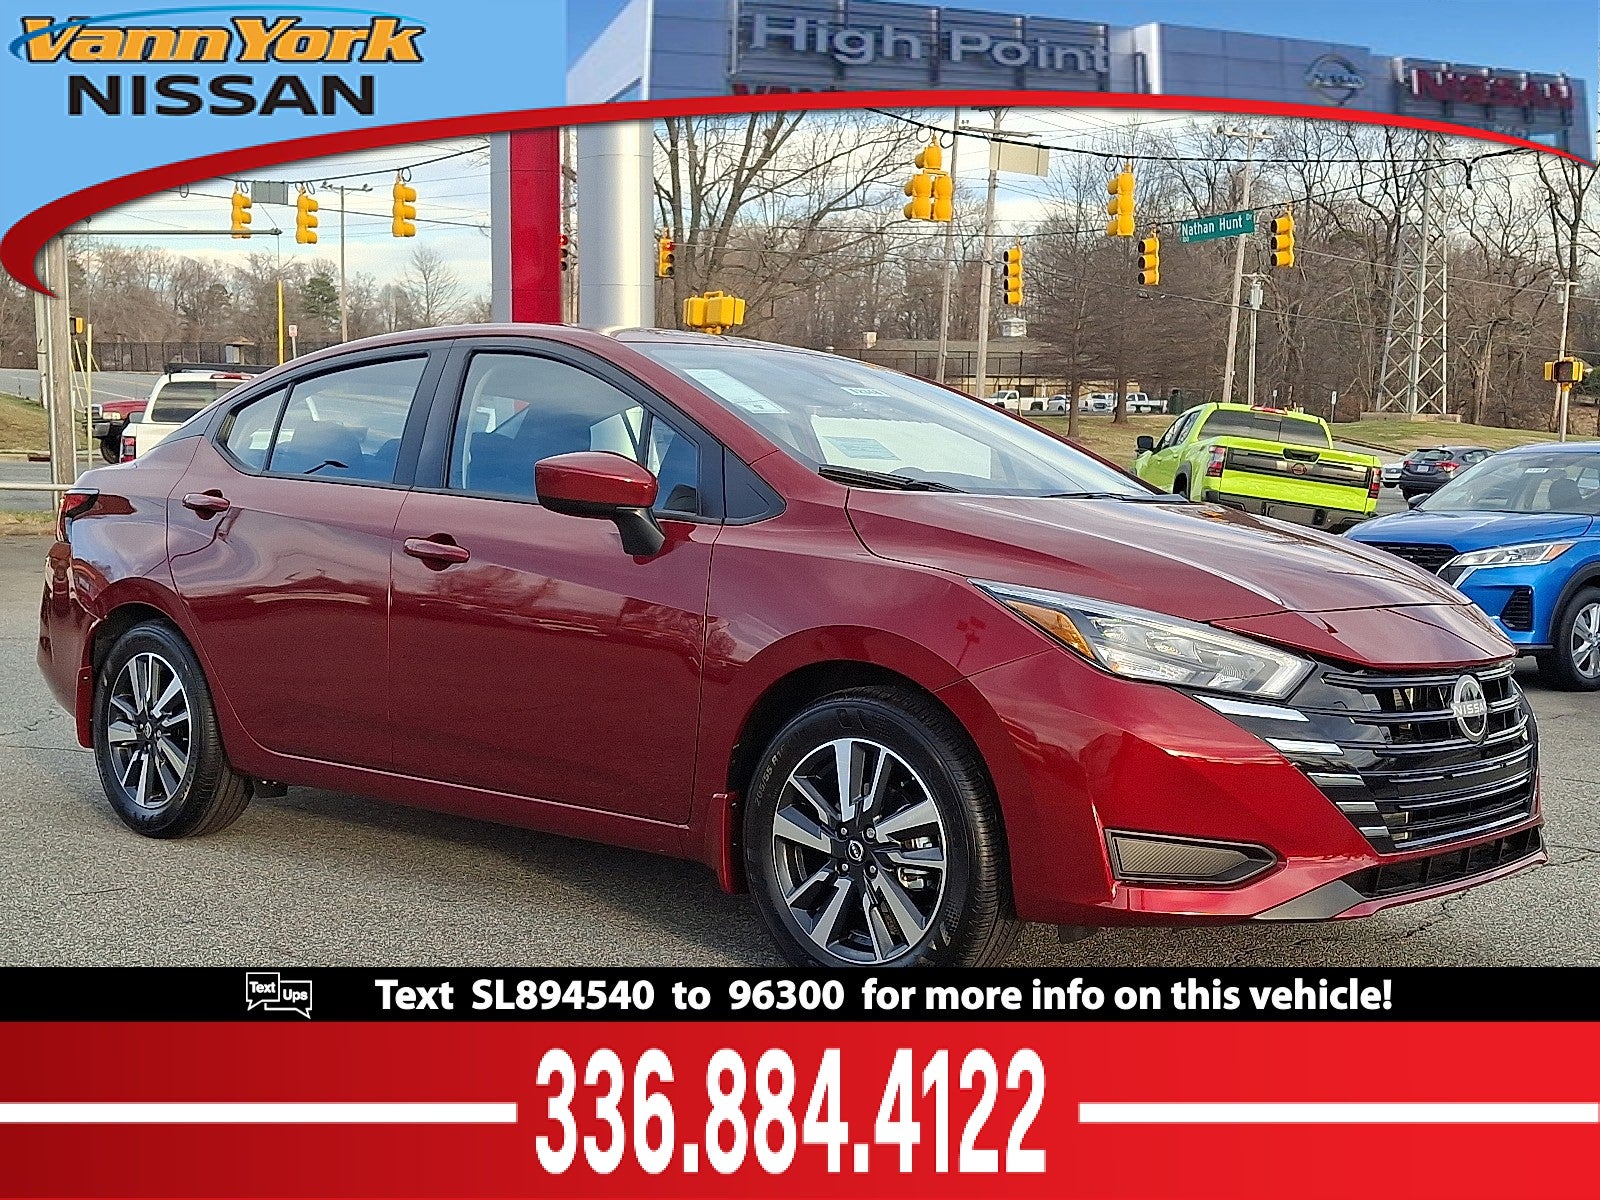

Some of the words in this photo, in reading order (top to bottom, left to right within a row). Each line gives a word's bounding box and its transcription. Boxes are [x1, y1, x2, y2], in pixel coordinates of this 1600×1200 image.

[749, 13, 922, 65] High
[950, 30, 1111, 73] Point
[1181, 222, 1215, 237] Nathan
[1219, 215, 1242, 231] Hunt
[1451, 702, 1487, 717] NISSA
